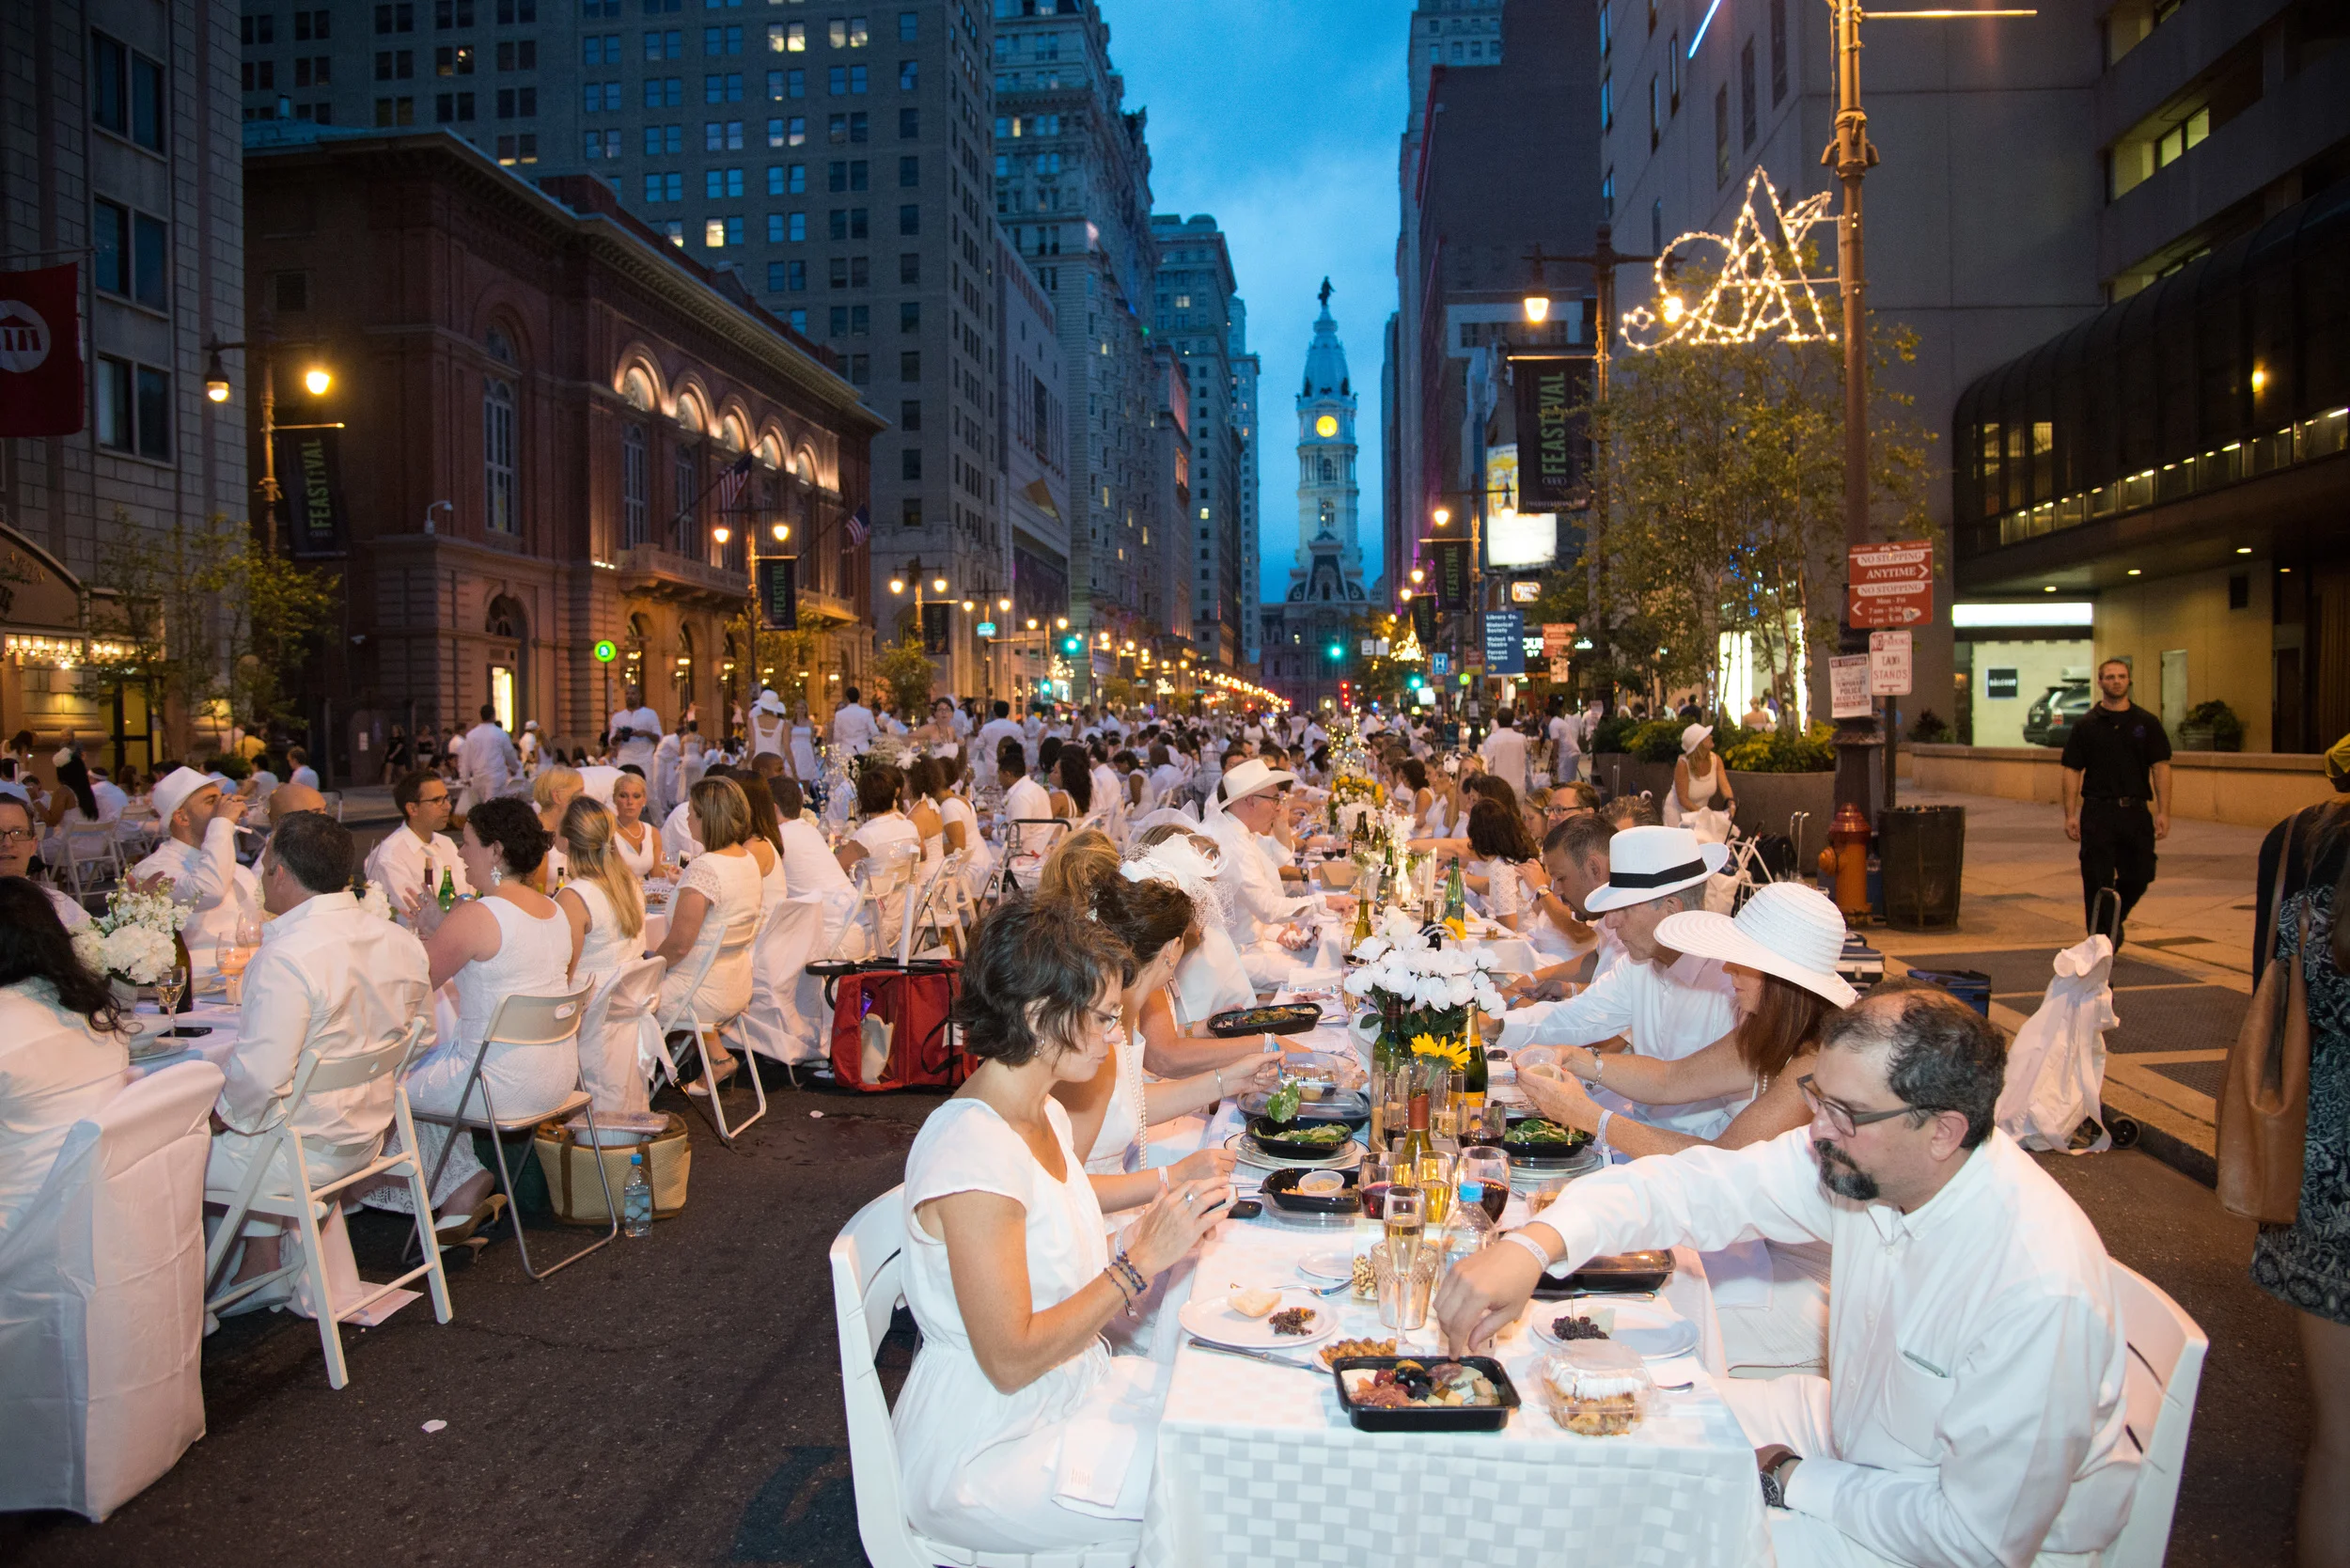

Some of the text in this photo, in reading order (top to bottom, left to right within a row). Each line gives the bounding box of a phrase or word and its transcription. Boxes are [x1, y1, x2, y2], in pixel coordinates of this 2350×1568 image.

[301, 438, 333, 528] FEASTIVAL
[1861, 551, 1921, 564] NO STOPPING
[1866, 567, 1917, 579] ANYTIME
[1861, 583, 1921, 594] NO STOPPING
[1882, 656, 1901, 666] TAXI
[1873, 668, 1907, 680] STANDS
